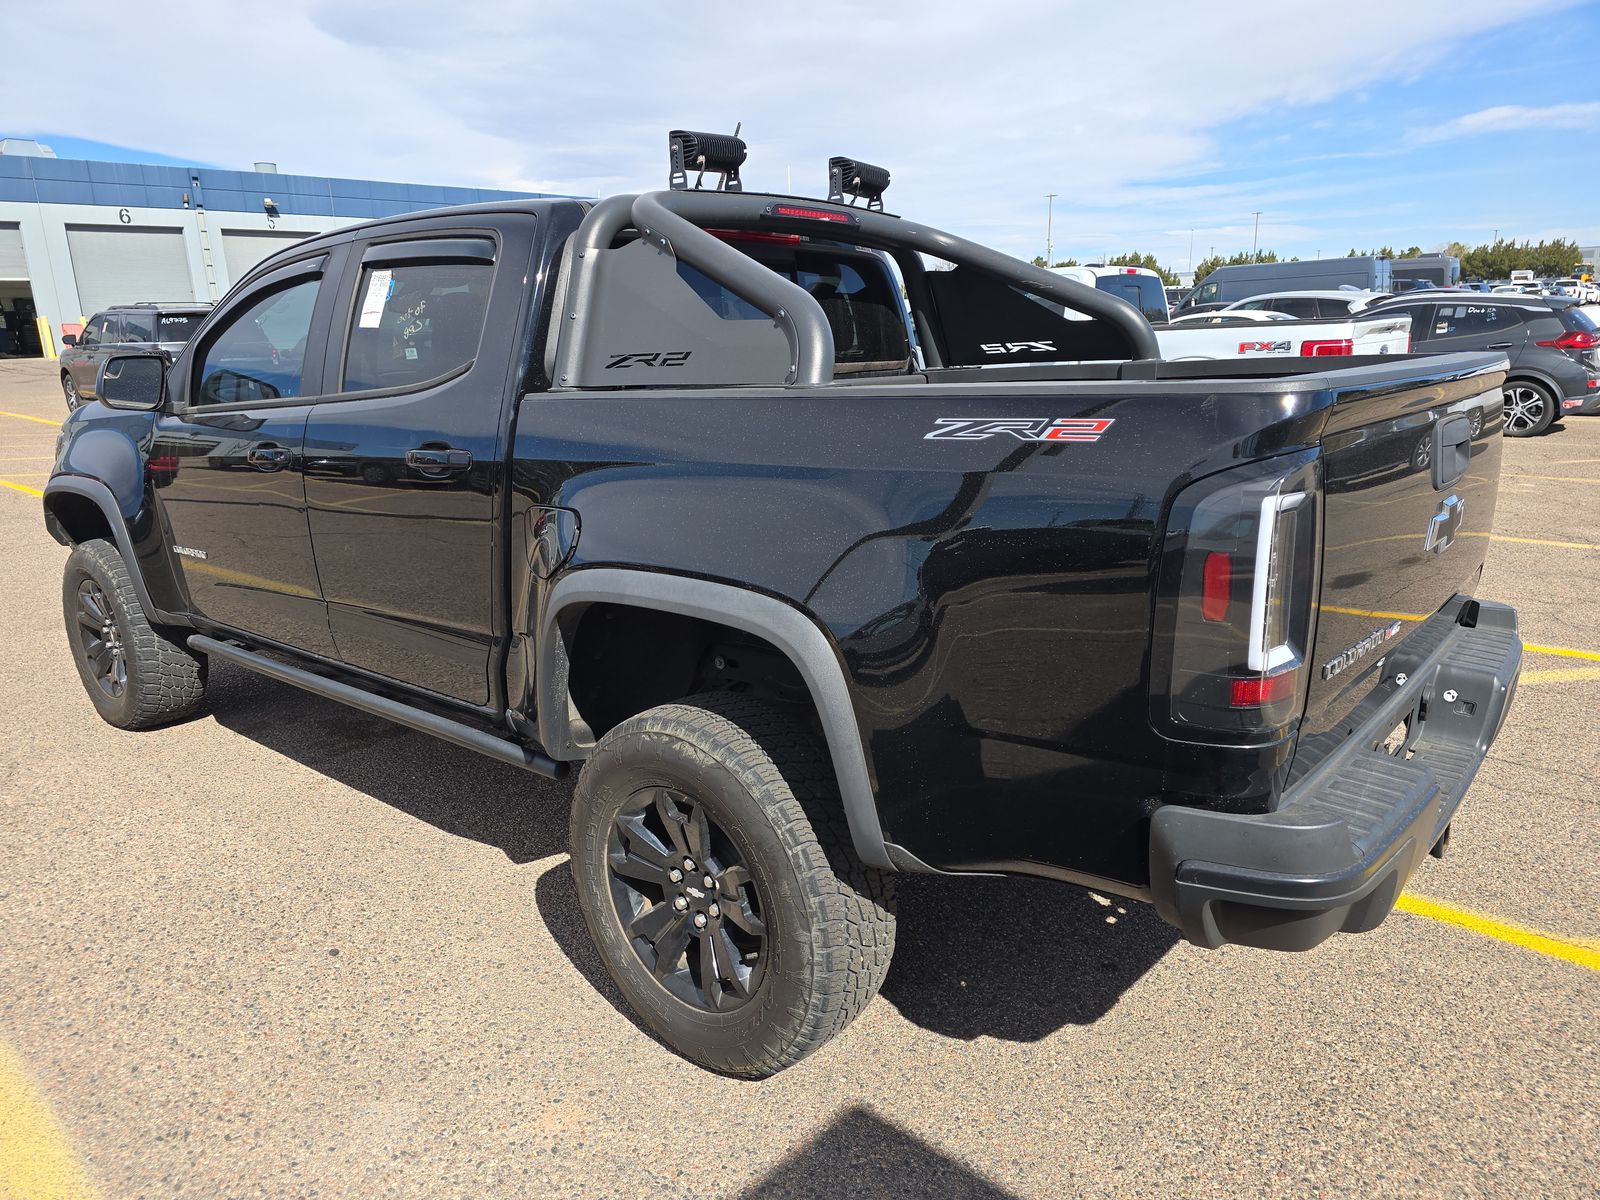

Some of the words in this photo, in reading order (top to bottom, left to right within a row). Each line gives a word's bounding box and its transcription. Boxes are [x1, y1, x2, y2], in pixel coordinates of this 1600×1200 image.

[119, 208, 132, 224] 6
[1238, 340, 1292, 355] FX4
[604, 351, 692, 369] ZR2
[923, 418, 1116, 442] ZR2
